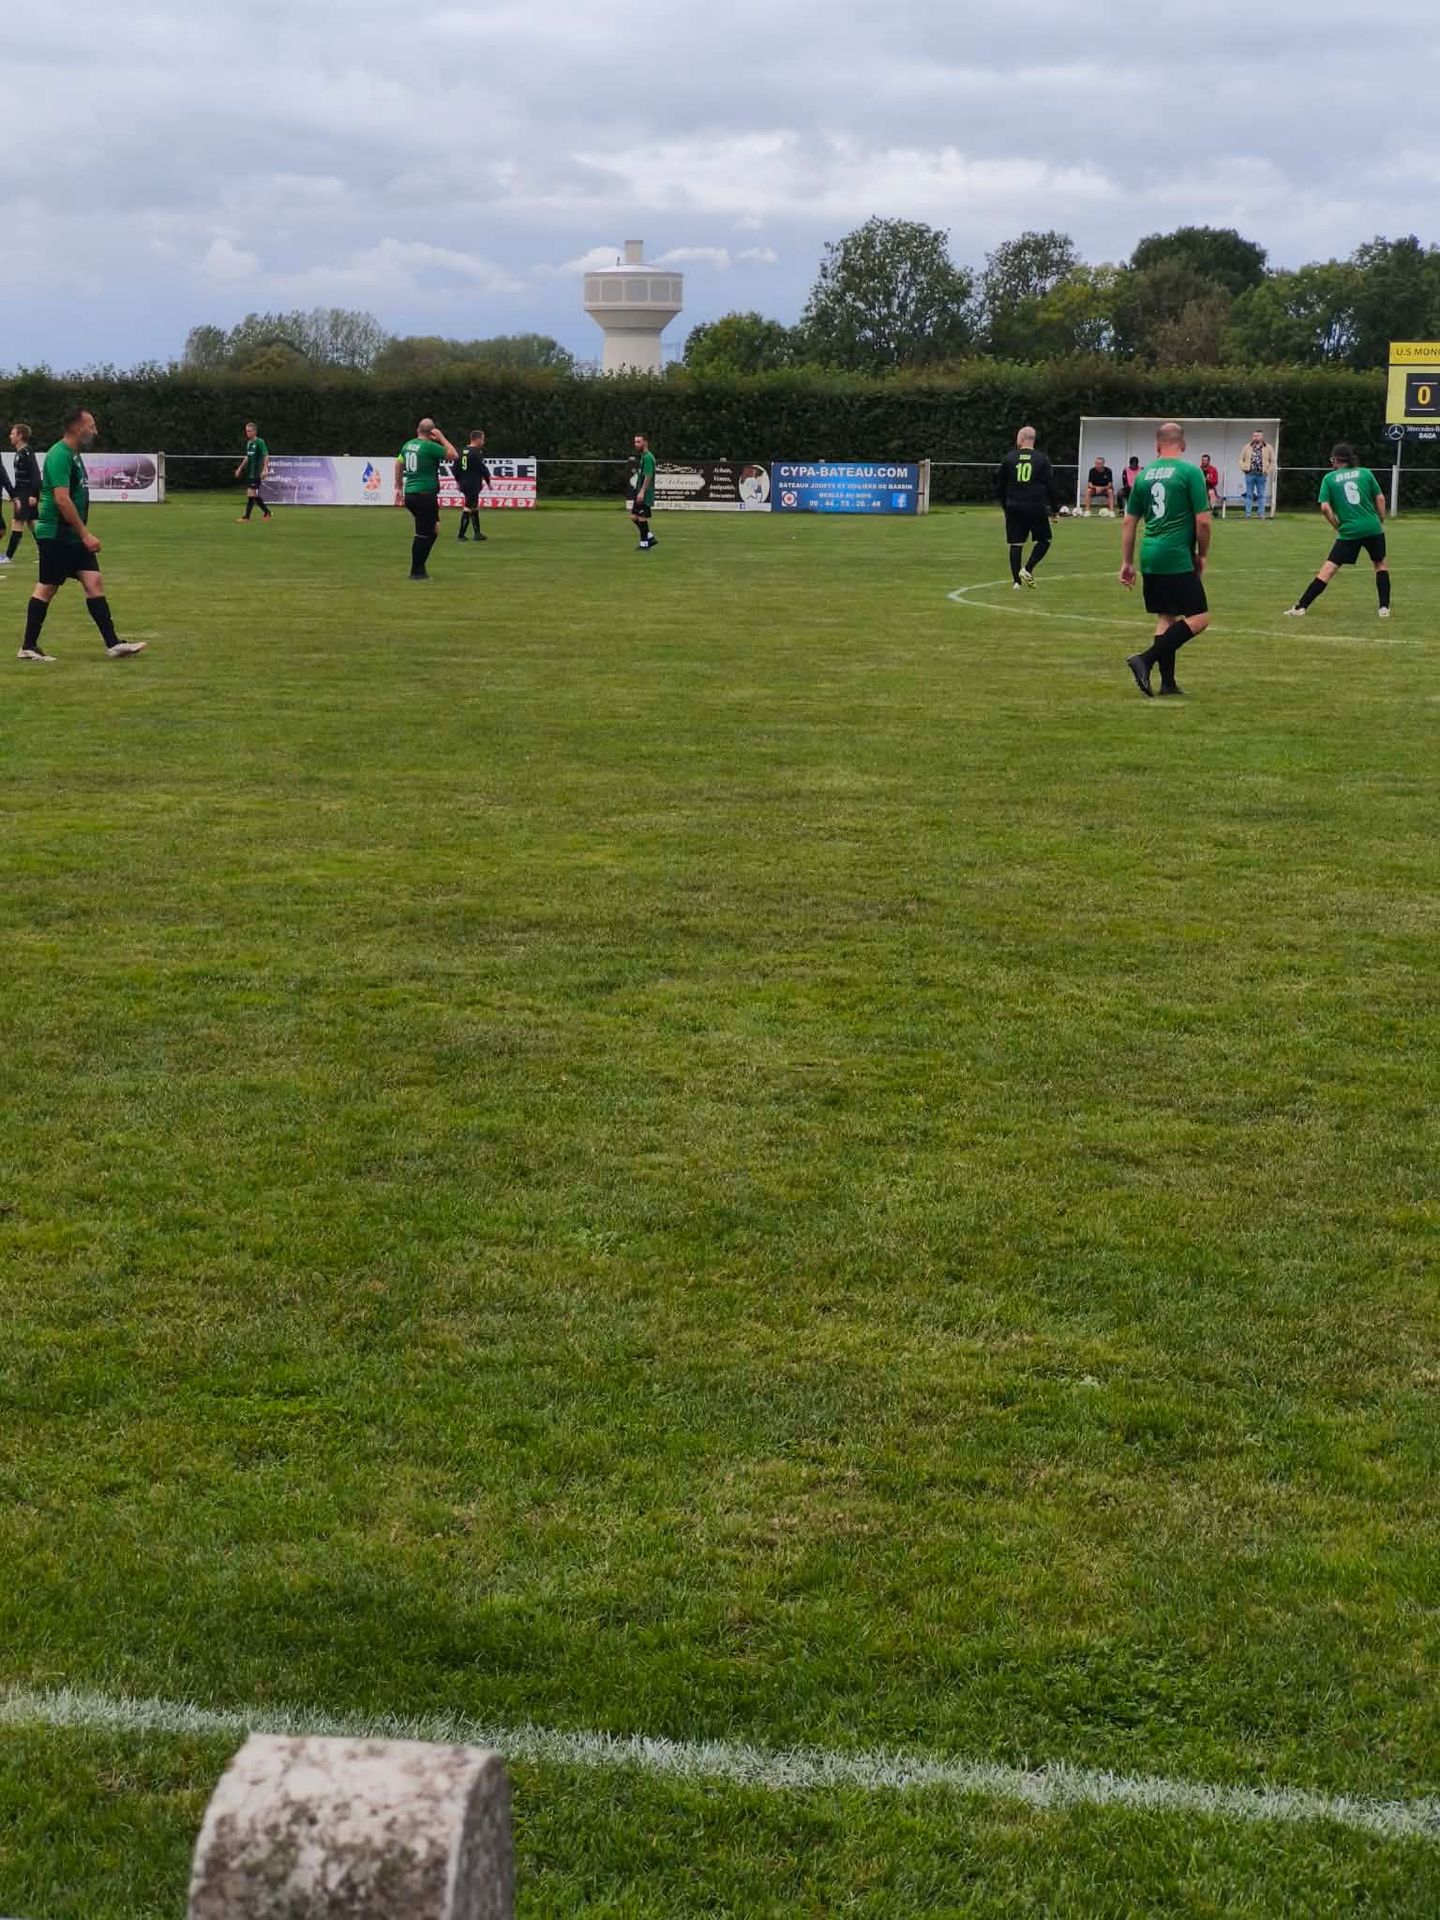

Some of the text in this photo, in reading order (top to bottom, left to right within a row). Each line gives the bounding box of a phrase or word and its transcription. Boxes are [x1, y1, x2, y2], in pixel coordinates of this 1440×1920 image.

[1418, 385, 1431, 405] 0
[405, 451, 418, 472] 10
[461, 455, 468, 471] 9
[780, 465, 908, 478] CYPA-BATEAU.COM
[1016, 462, 1032, 482] 10
[1150, 482, 1166, 519] 3
[1343, 480, 1361, 505] 6
